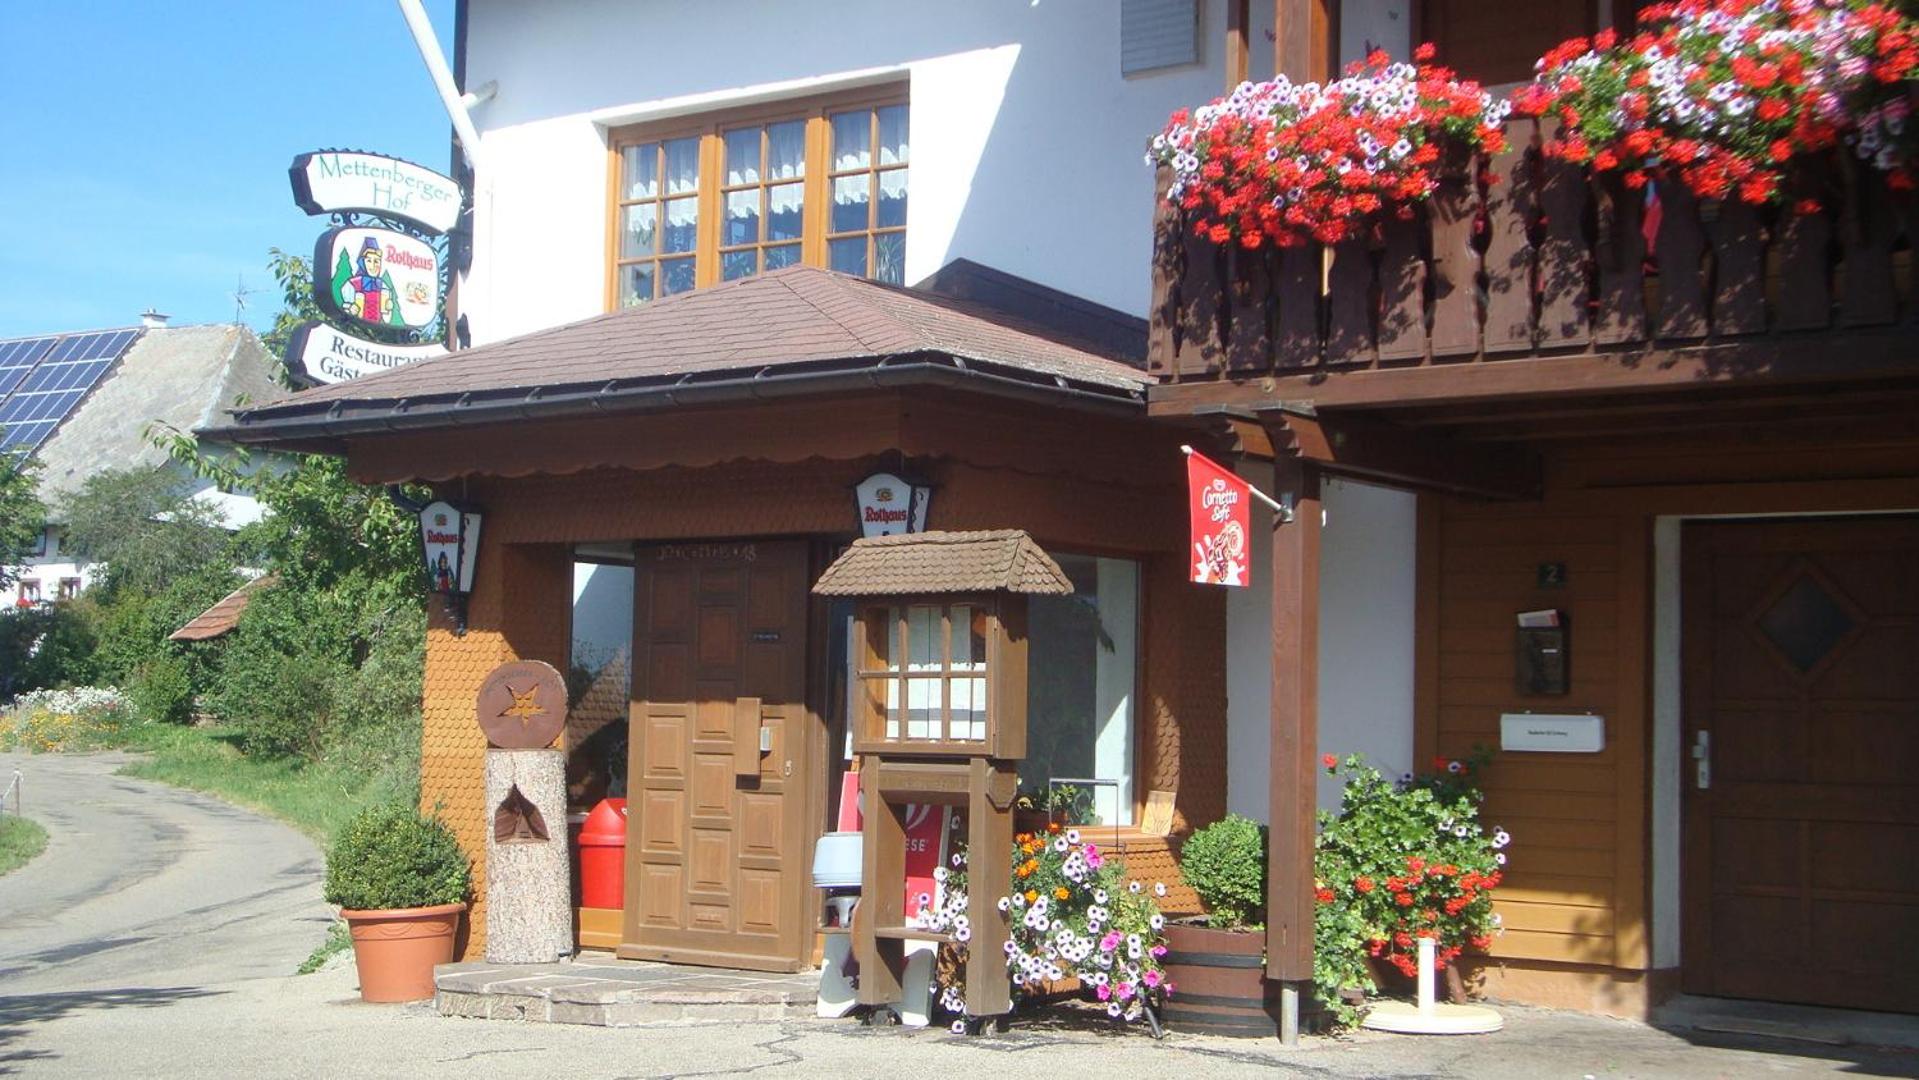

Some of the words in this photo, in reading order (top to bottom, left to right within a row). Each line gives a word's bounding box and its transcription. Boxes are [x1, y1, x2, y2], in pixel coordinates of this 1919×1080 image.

[319, 154, 453, 202] Mettenberger
[372, 182, 413, 210] Hof
[385, 244, 433, 271] Rothaus
[331, 335, 426, 367] Restaura
[320, 356, 366, 380] Gäst
[1202, 486, 1239, 509] Cornetto
[865, 506, 907, 524] Rothaus
[1211, 505, 1230, 523] Soft
[426, 530, 458, 546] Rothaus
[1546, 565, 1558, 582] 2
